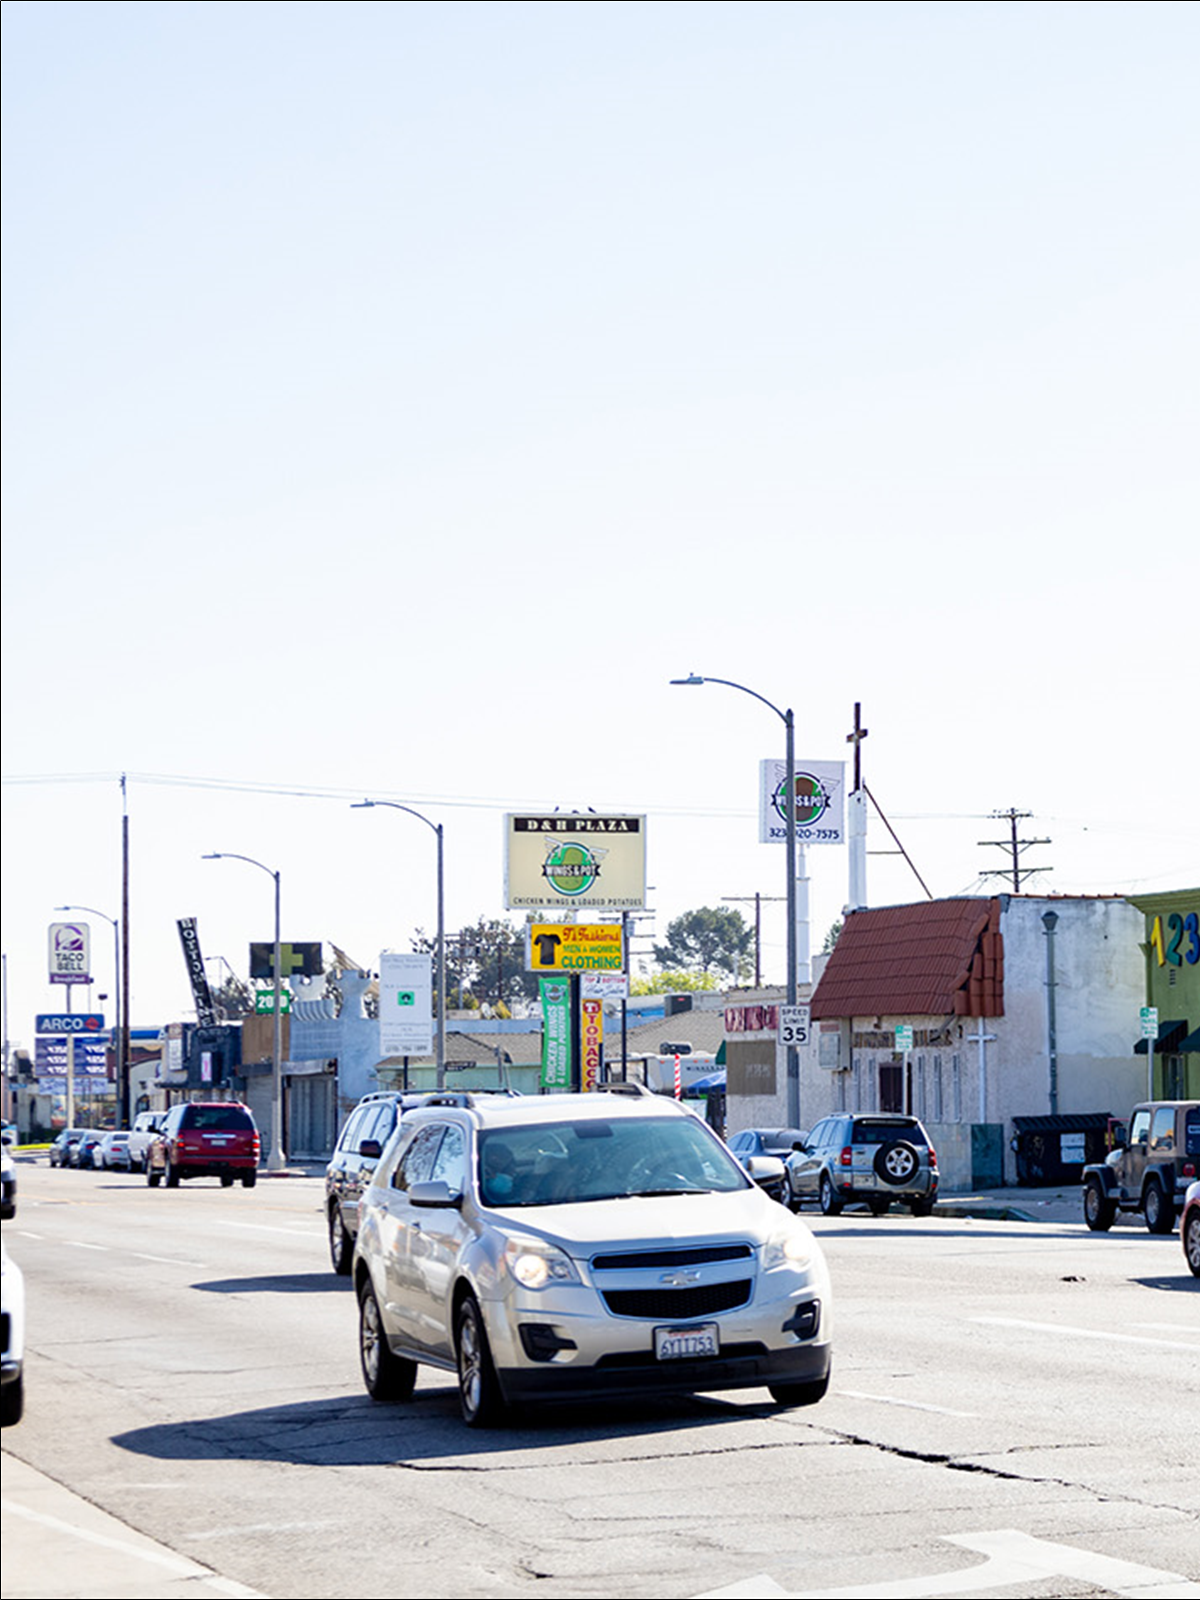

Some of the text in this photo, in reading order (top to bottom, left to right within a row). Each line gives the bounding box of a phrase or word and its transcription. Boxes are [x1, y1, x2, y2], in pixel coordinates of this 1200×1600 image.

[575, 820, 629, 831] PLAZA
[513, 896, 544, 905] CHICKEN
[547, 897, 569, 906] WINGS
[579, 897, 605, 906] LOADED
[607, 897, 642, 906] POTATOES
[1151, 912, 1200, 967] 123
[562, 944, 581, 953] MEN
[589, 944, 621, 953] WOMEN
[55, 952, 84, 961] TACO
[561, 955, 622, 968] CLOTHING
[57, 962, 83, 971] BELL
[41, 1018, 84, 1030] ARCO
[547, 1005, 558, 1038] WINGS
[782, 1027, 807, 1042] 35
[545, 1040, 558, 1084] CHICKEN
